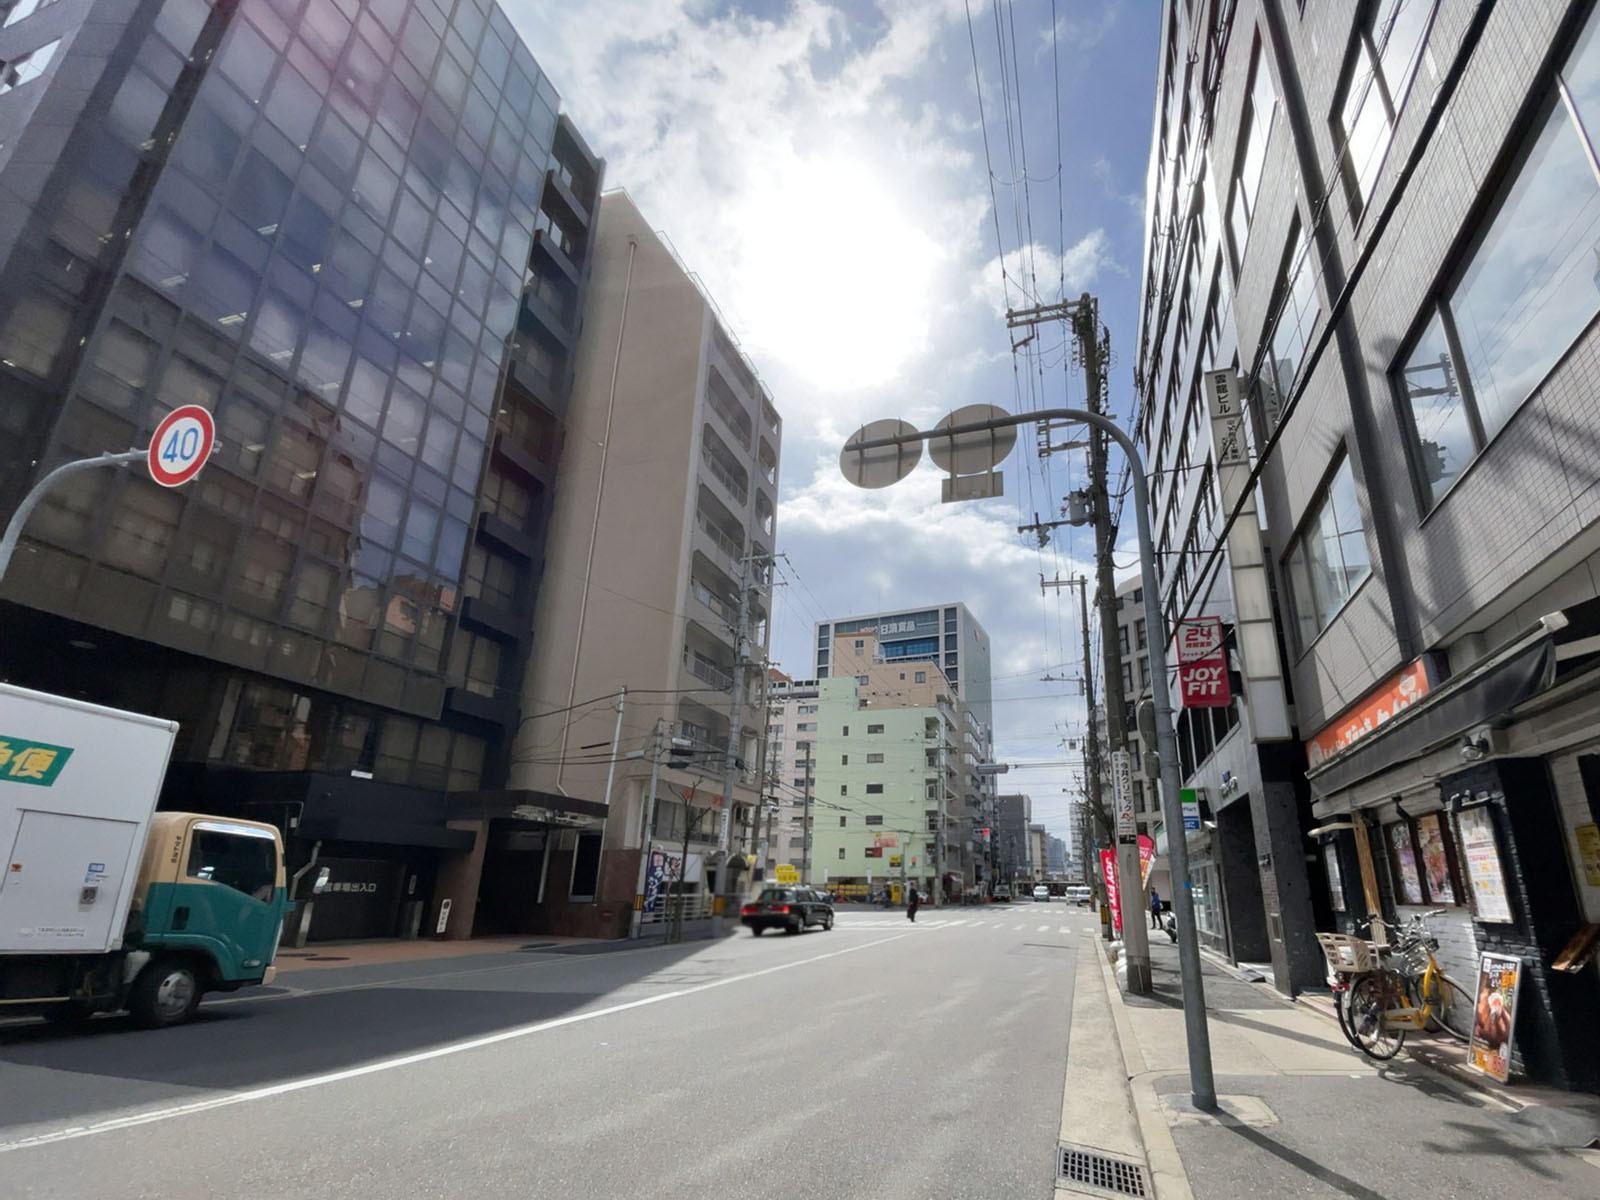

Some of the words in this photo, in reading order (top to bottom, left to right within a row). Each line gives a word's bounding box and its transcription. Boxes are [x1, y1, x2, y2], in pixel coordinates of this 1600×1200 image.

[162, 427, 199, 463] 40
[880, 621, 916, 635] 日清食品
[1185, 627, 1213, 642] 24
[1183, 666, 1224, 682] JOY
[1187, 680, 1222, 697] FIT
